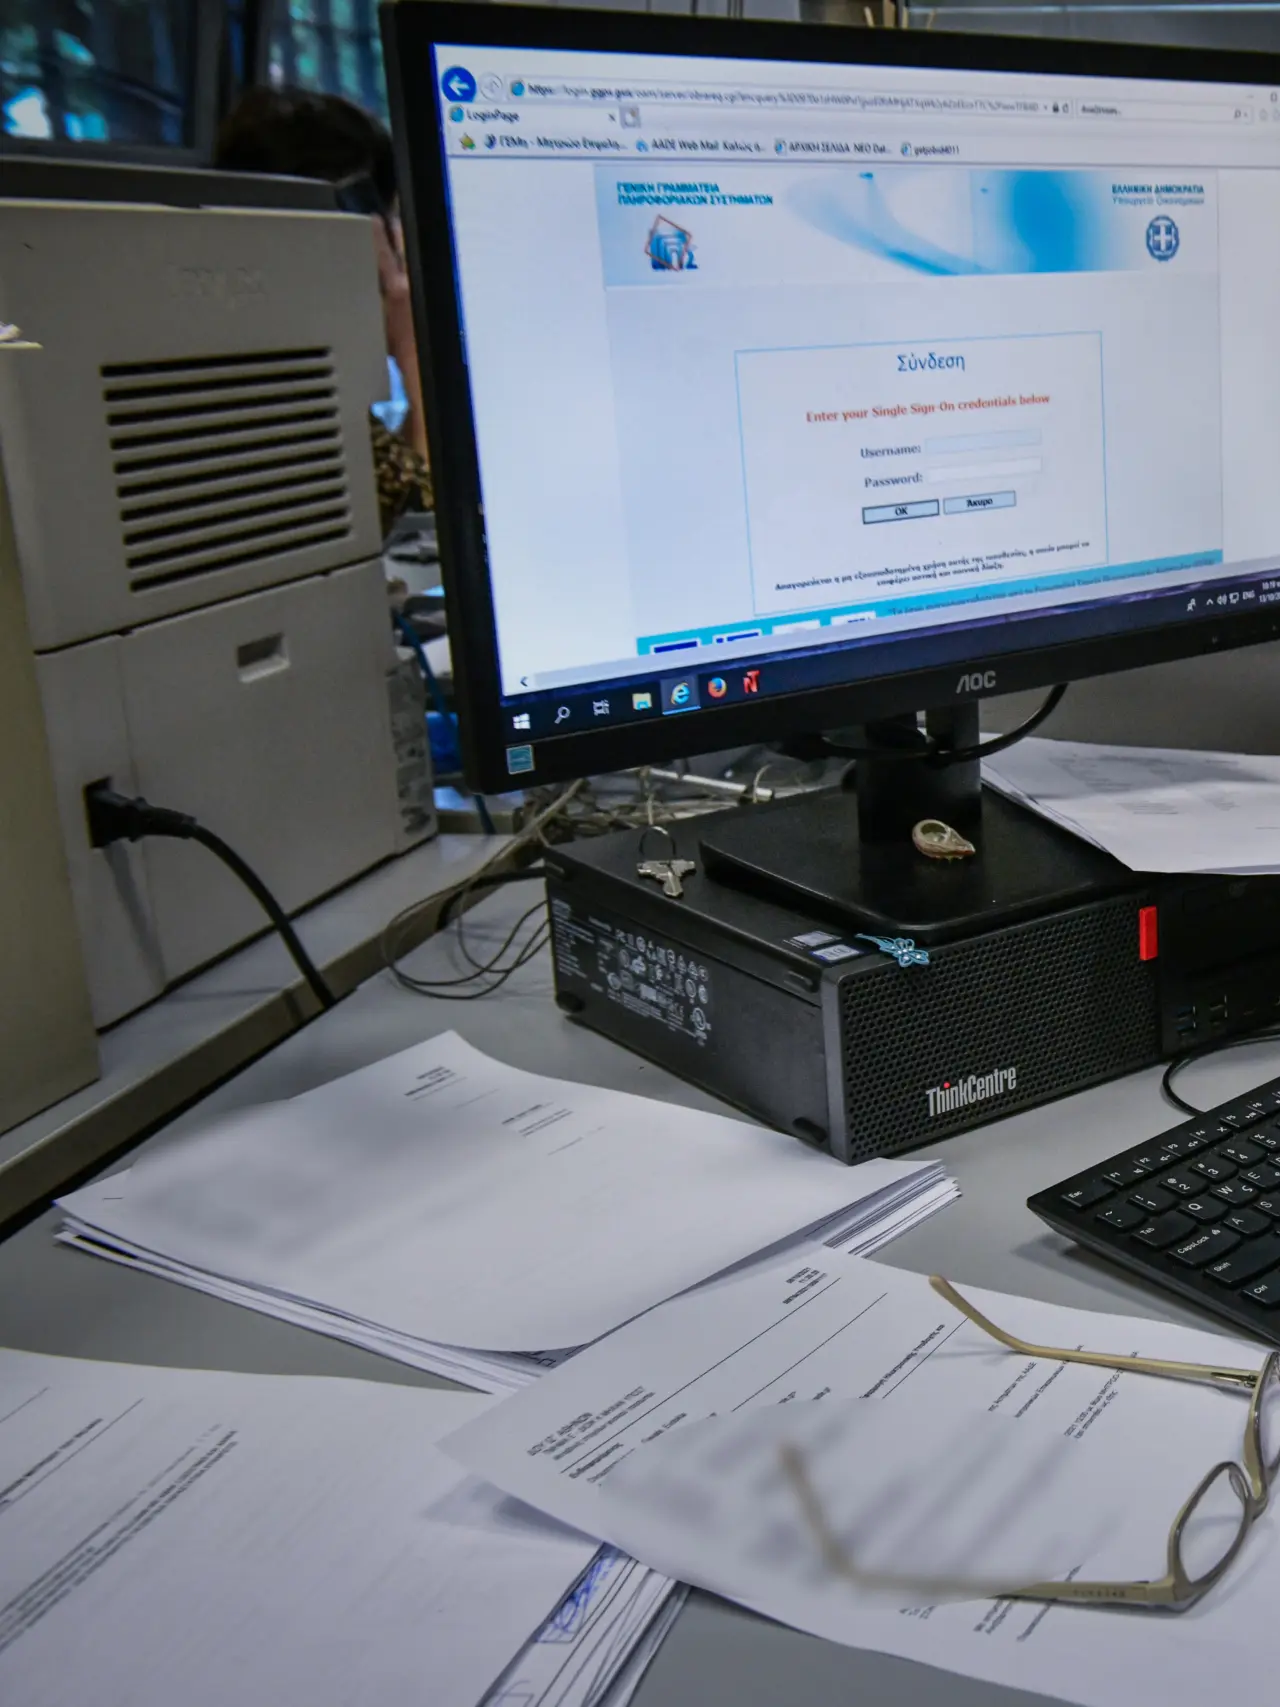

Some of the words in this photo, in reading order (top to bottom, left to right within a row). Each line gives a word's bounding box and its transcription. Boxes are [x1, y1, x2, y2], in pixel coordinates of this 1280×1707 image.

[1111, 184, 1152, 194] ΕΛΛΗΝΙΚΗ
[1154, 184, 1204, 194] ΔΗΜΟΚΡΑΤΙΑ
[896, 351, 966, 373] Σύνδεση
[806, 410, 839, 423] Enter
[842, 410, 868, 423] your
[871, 404, 907, 418] Single
[957, 395, 1016, 411] credentials
[1019, 393, 1050, 405] below
[860, 444, 922, 459] Username:
[864, 472, 924, 488] Password:
[895, 506, 908, 516] OK
[955, 670, 996, 694] AOC
[925, 1066, 1017, 1117] ThinkCentre
[1179, 1183, 1191, 1191] 2
[1217, 1186, 1233, 1195] W
[1069, 1190, 1083, 1199] Esc
[1188, 1203, 1203, 1211] Q
[1140, 1227, 1155, 1235] Tab
[1177, 1235, 1210, 1255] CapsLock
[1213, 1262, 1232, 1273] Shift
[1253, 1284, 1269, 1294] Ctrl
